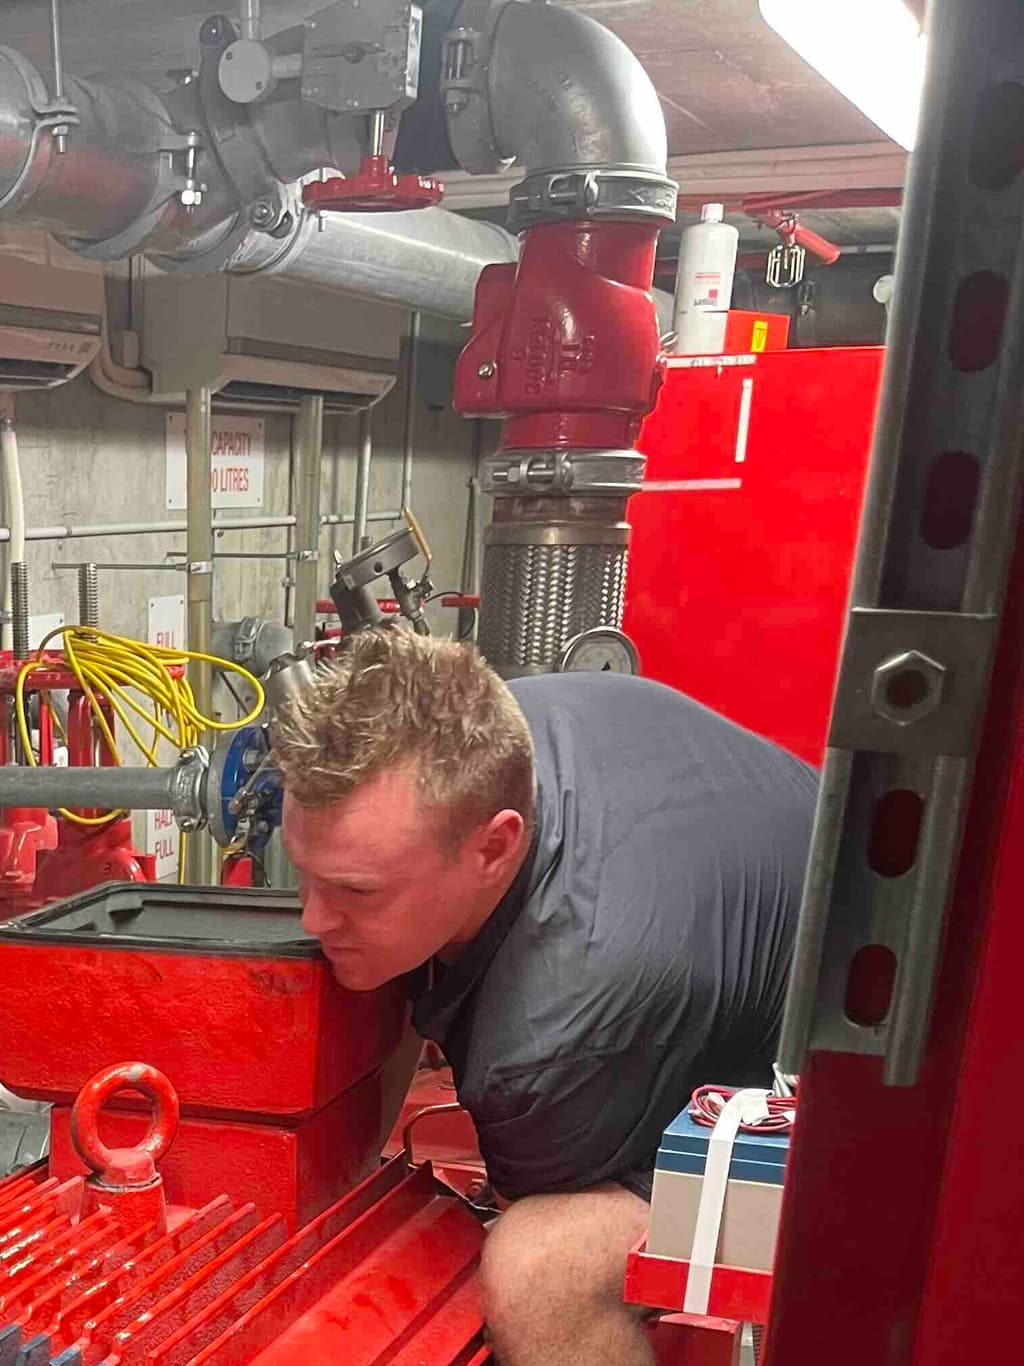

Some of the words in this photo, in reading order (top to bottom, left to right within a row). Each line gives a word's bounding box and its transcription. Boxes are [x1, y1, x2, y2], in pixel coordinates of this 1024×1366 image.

[211, 431, 252, 456] CAPACITY
[220, 467, 249, 492] LITRES
[155, 838, 175, 859] FULL
